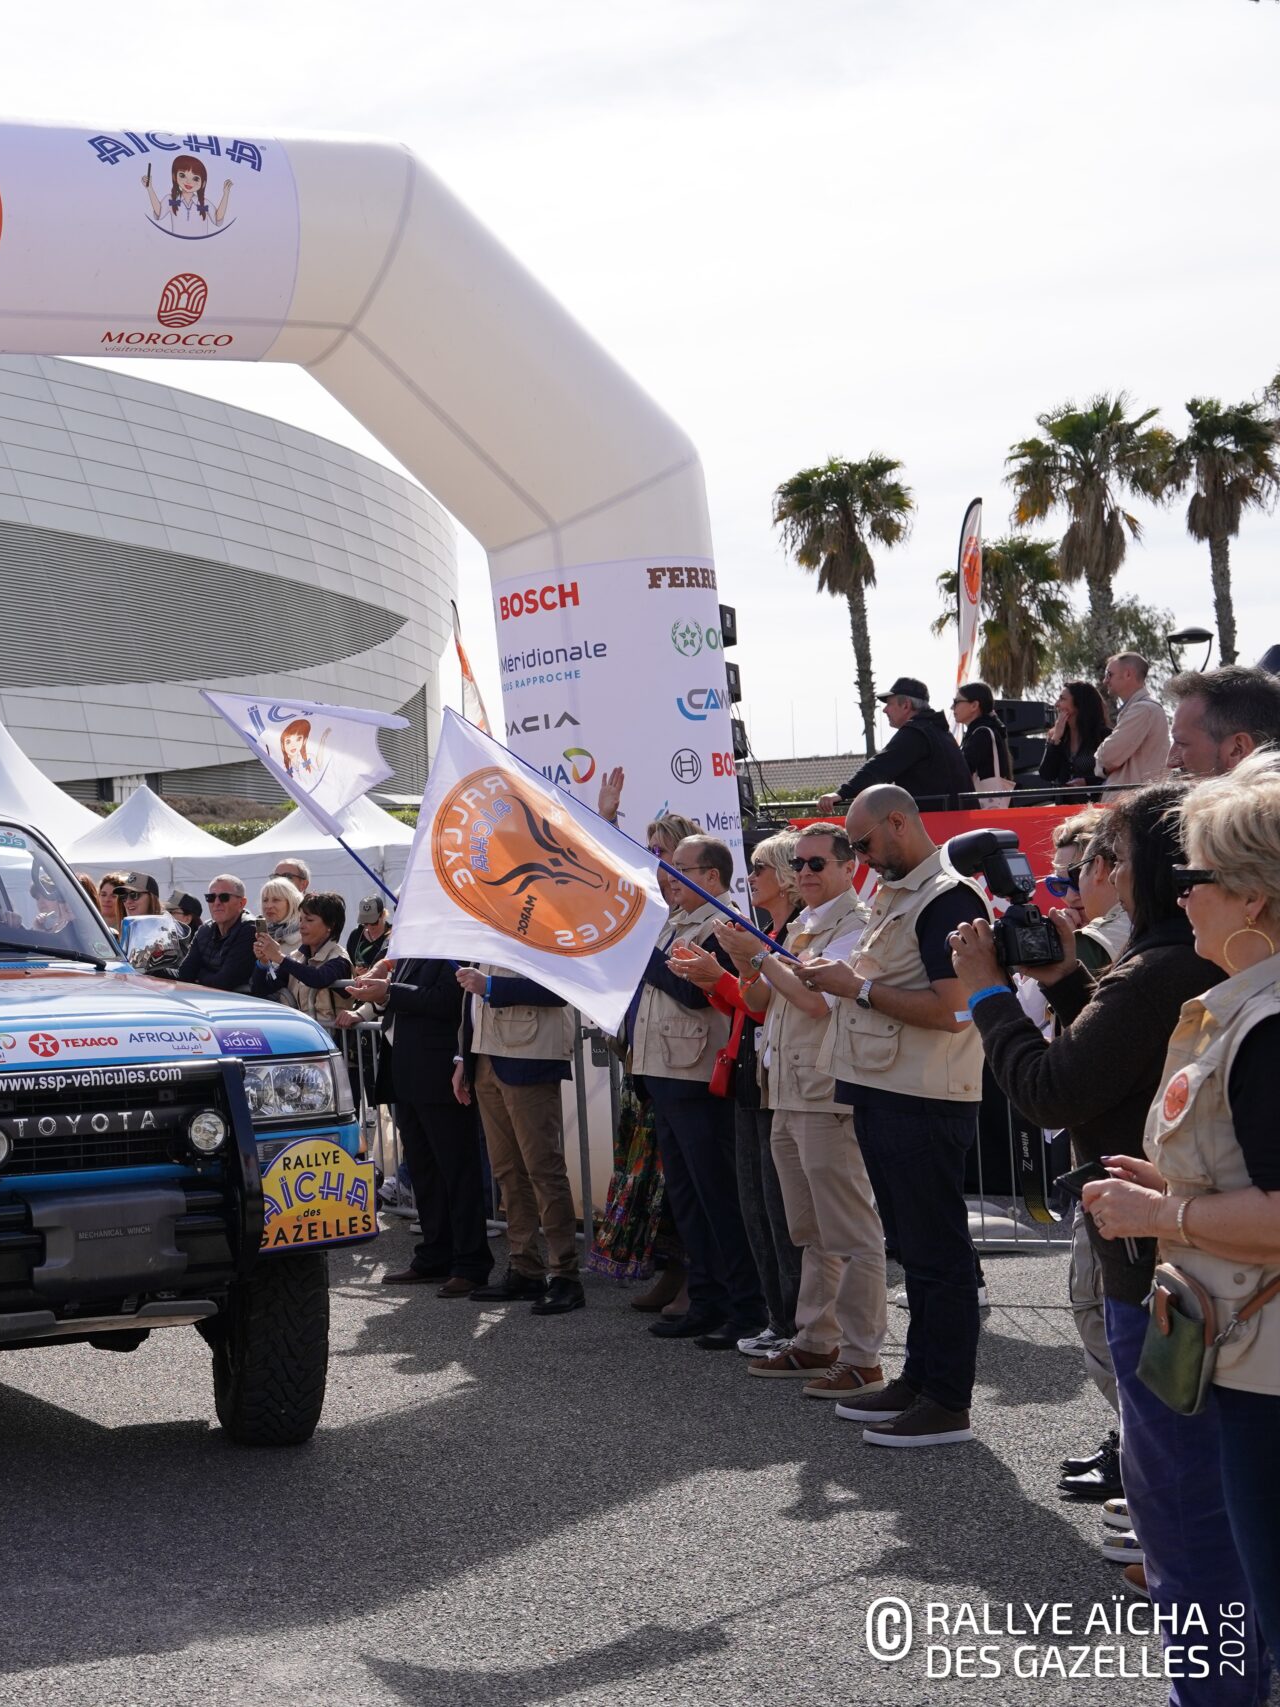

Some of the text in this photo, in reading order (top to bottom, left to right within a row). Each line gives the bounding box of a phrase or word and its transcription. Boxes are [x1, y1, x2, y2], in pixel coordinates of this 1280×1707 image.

[100, 331, 233, 347] MOROCCO
[104, 346, 217, 355] visitmorocco.com
[499, 582, 580, 621] BOSCH
[500, 640, 607, 674] Méridionale
[515, 669, 582, 688] RAPPROCHE
[61, 1036, 118, 1048] TEXACO
[129, 1031, 199, 1044] AFRIQUIA
[222, 1035, 262, 1047] sidi ali
[13, 1111, 156, 1137] TOYOTA
[1021, 1131, 1030, 1158] Nikon
[283, 1150, 340, 1171] RALLYE
[303, 1208, 321, 1217] des
[78, 1224, 151, 1239] MECHANICAL WINCH
